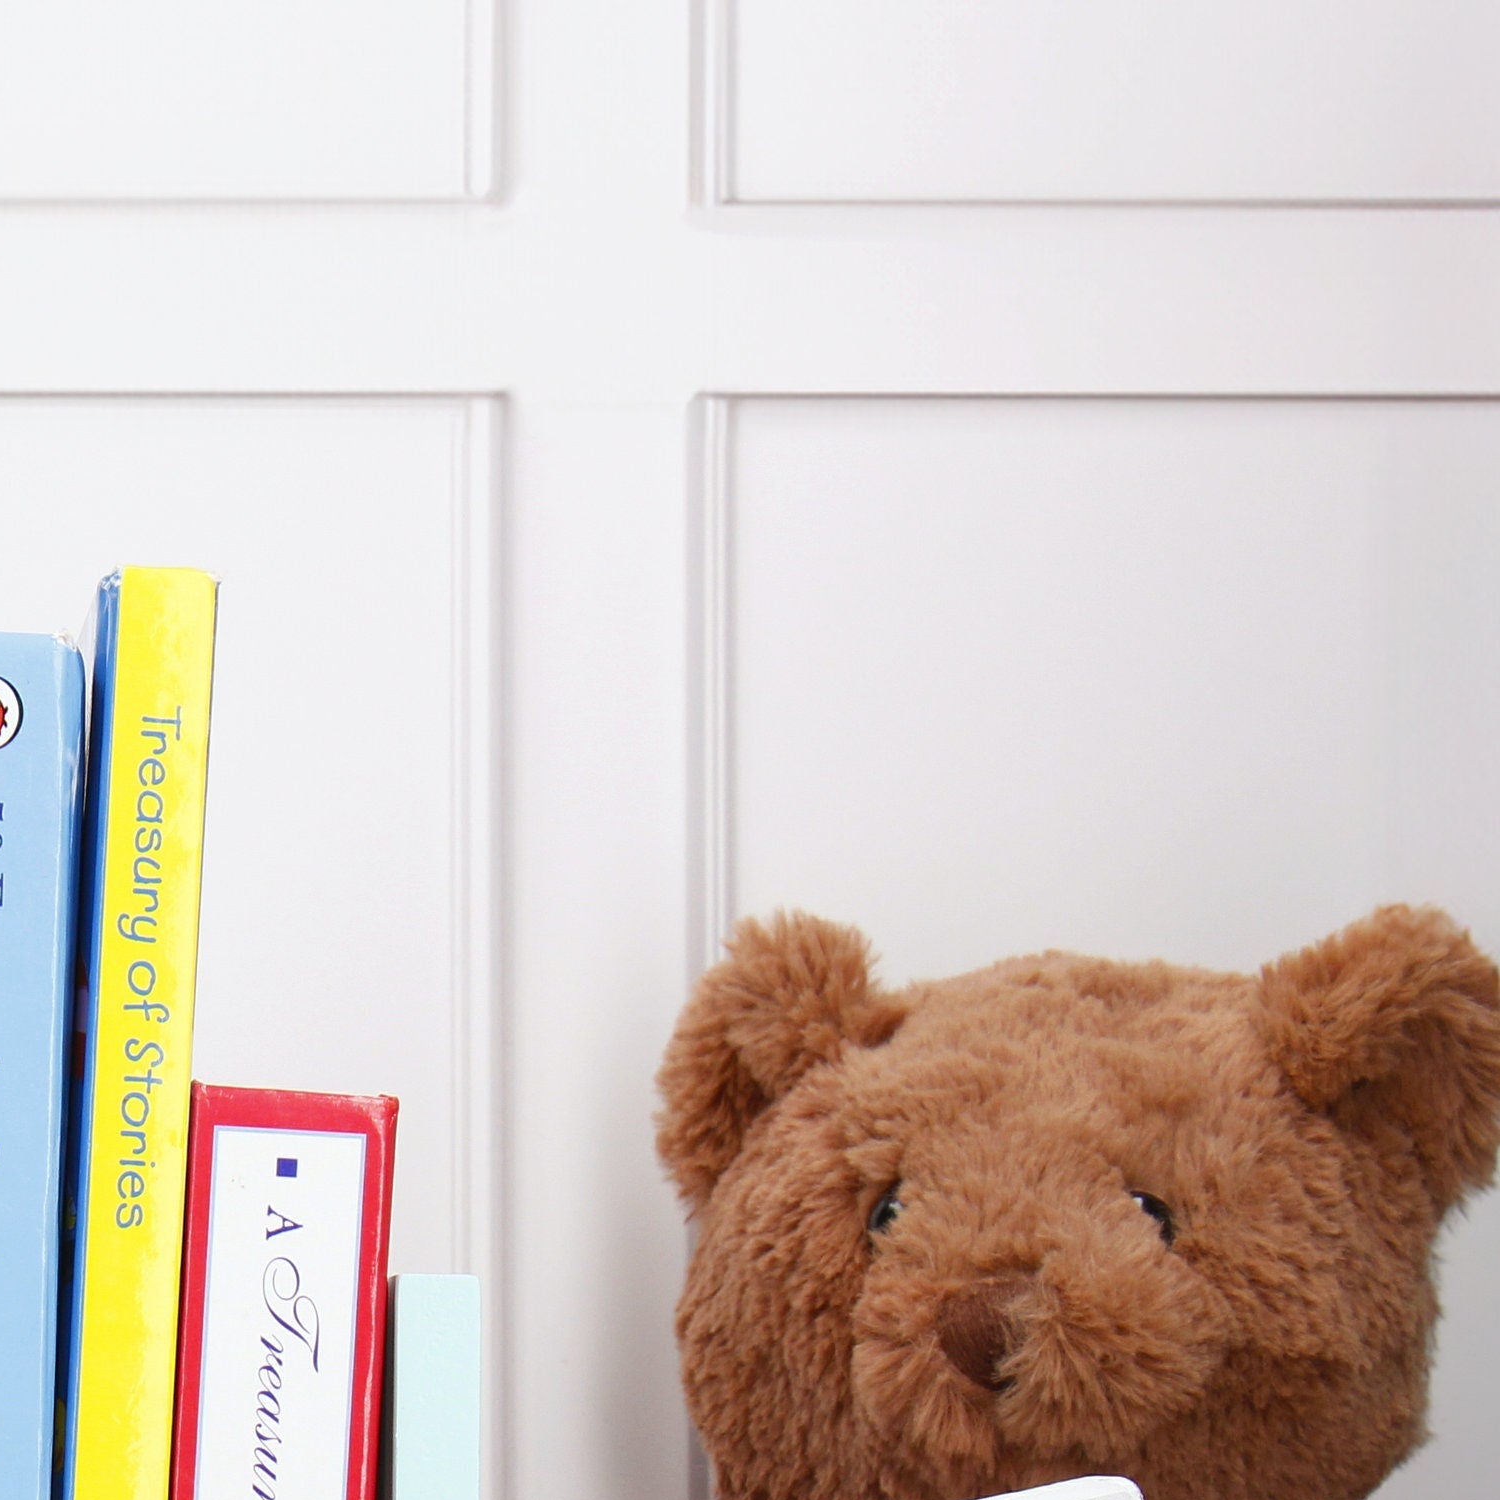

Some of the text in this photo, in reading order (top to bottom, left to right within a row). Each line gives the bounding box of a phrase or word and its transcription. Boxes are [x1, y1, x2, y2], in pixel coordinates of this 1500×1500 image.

[115, 705, 182, 1230] Treasury of Stories
[265, 1204, 304, 1241] A
